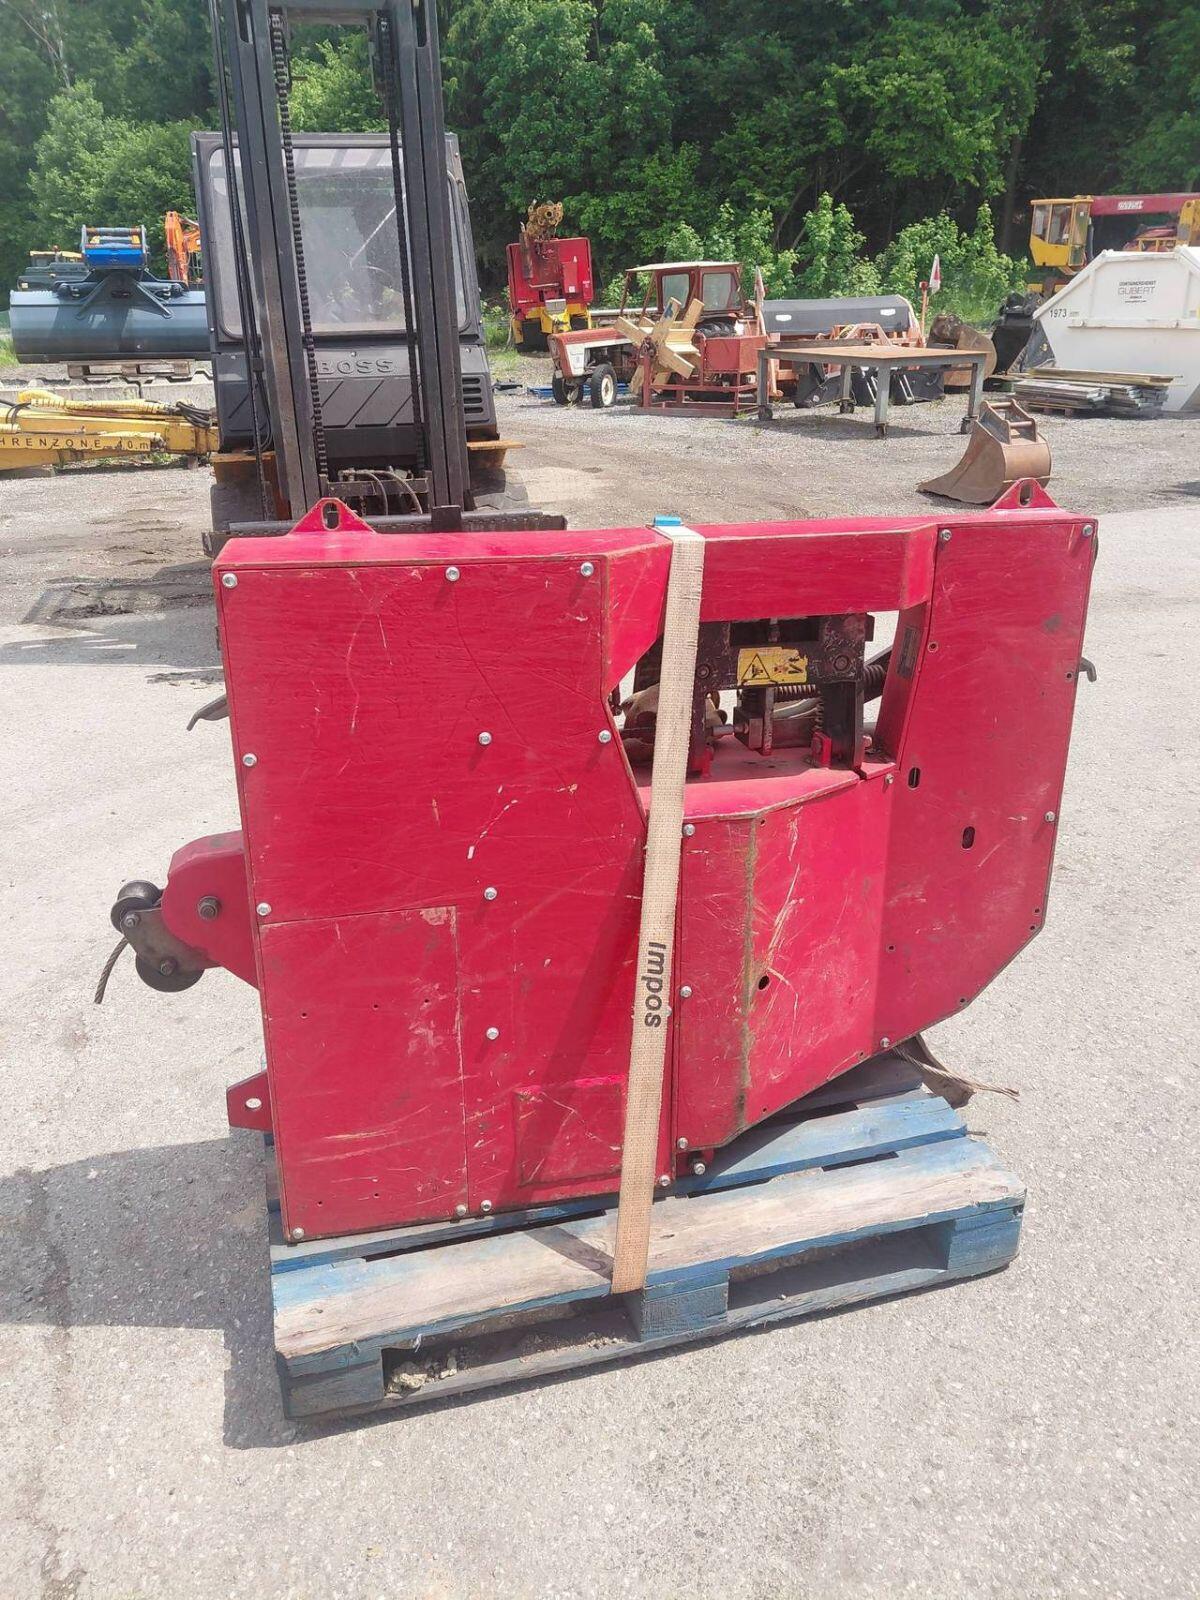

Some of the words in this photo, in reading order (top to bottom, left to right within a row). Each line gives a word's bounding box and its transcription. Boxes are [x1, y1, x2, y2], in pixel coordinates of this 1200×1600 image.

[1050, 308, 1067, 318] 1973
[316, 359, 394, 375] BOSS
[641, 941, 667, 1028] Impos
